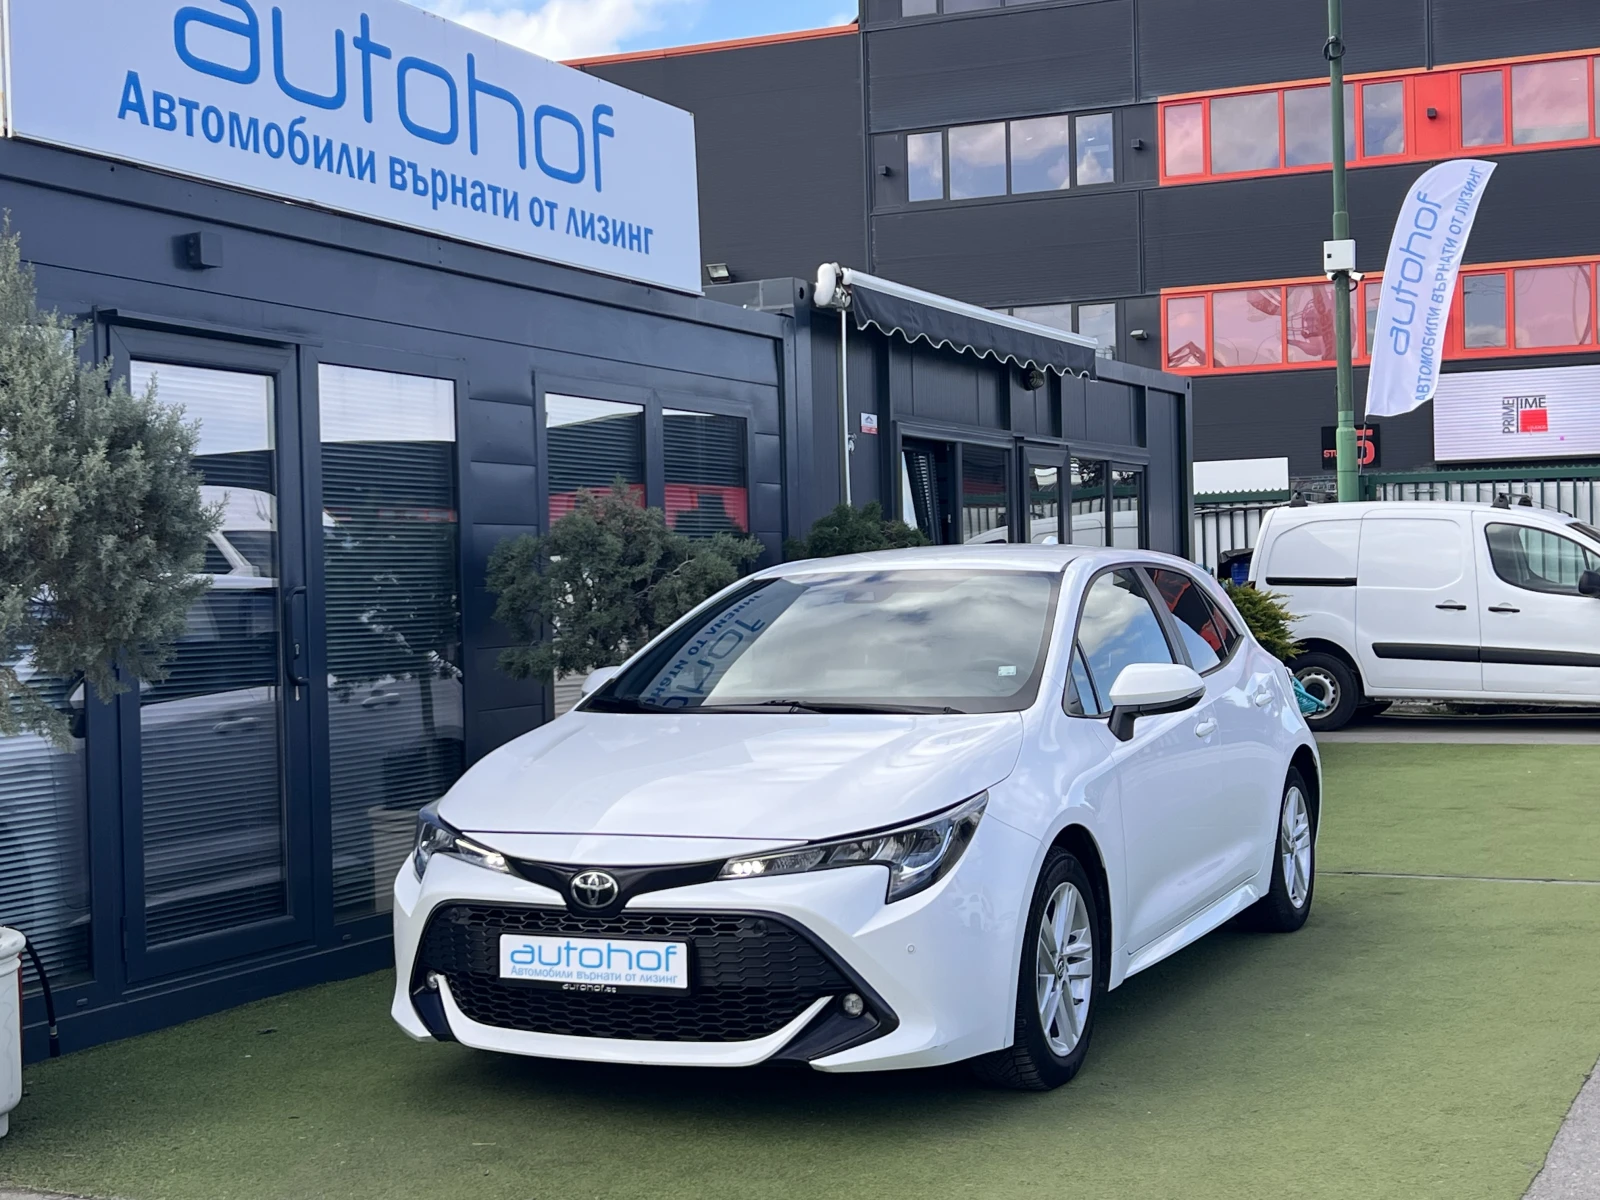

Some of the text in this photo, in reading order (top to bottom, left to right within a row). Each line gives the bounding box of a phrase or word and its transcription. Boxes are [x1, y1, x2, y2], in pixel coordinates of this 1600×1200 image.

[117, 70, 653, 255] Автомобили върнати от лизинг
[174, 0, 614, 192] autohof
[1390, 191, 1442, 355] autohof
[1415, 166, 1482, 400] АВТОМОБИЛИ ВЪРНАТИ ОТ ЛИЗИНГ
[1502, 399, 1515, 434] PRIME
[510, 941, 678, 972] autohof
[511, 965, 678, 984] Автомобили върнати от лизинг
